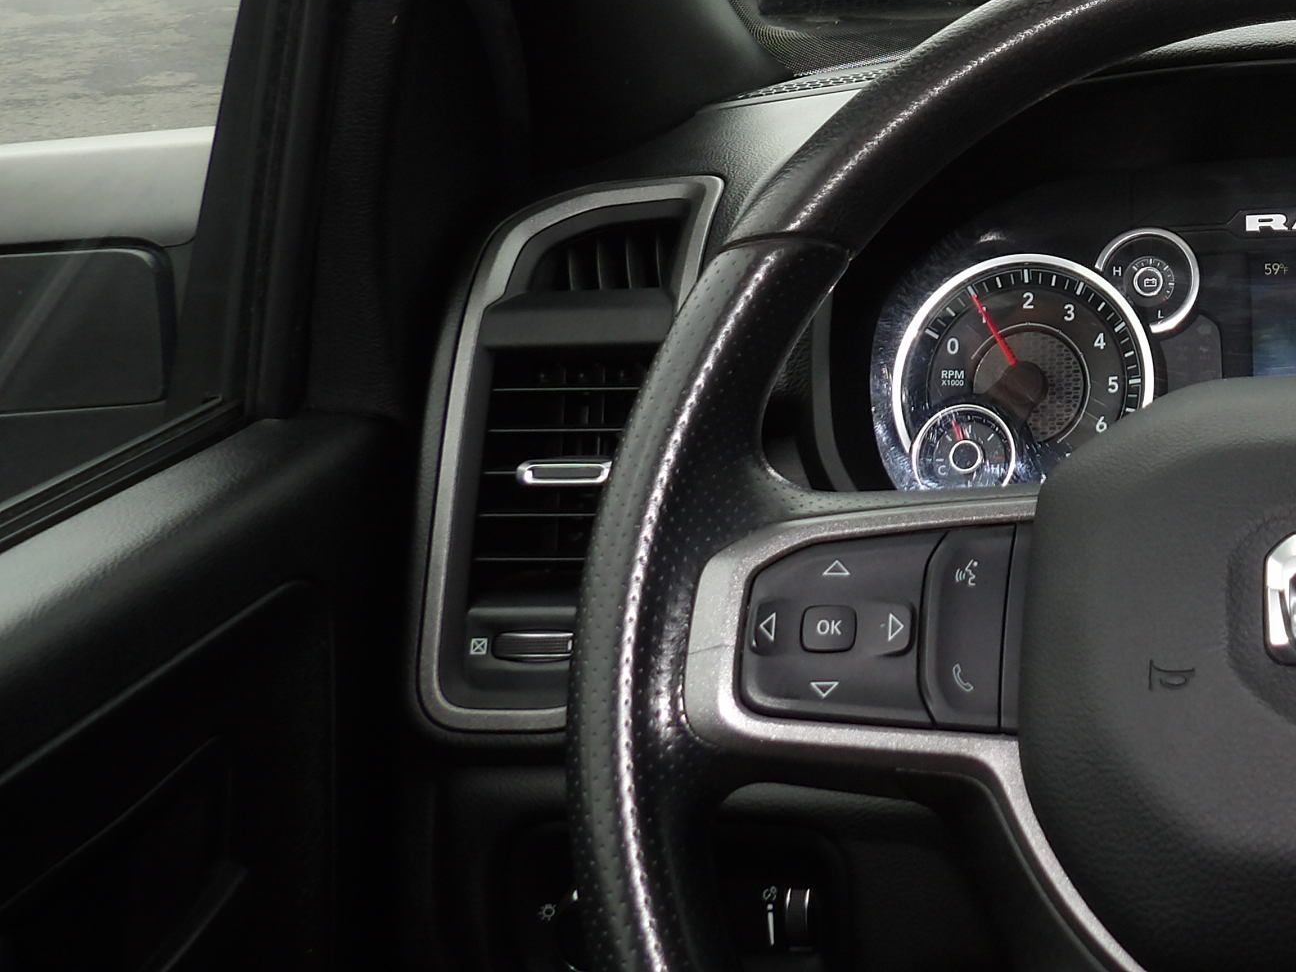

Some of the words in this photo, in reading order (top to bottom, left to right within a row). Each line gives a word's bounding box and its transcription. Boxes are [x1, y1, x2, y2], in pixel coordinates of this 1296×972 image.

[1112, 266, 1122, 277] H
[1022, 292, 1034, 309] 2
[1063, 304, 1075, 321] 3
[1157, 309, 1165, 319] L
[946, 337, 960, 355] 0
[1093, 332, 1107, 350] 4
[941, 369, 965, 379] RPM
[941, 379, 965, 387] X1000
[1107, 375, 1119, 393] 5
[1095, 415, 1108, 433] 6
[937, 464, 948, 476] C
[816, 618, 842, 636] OK
